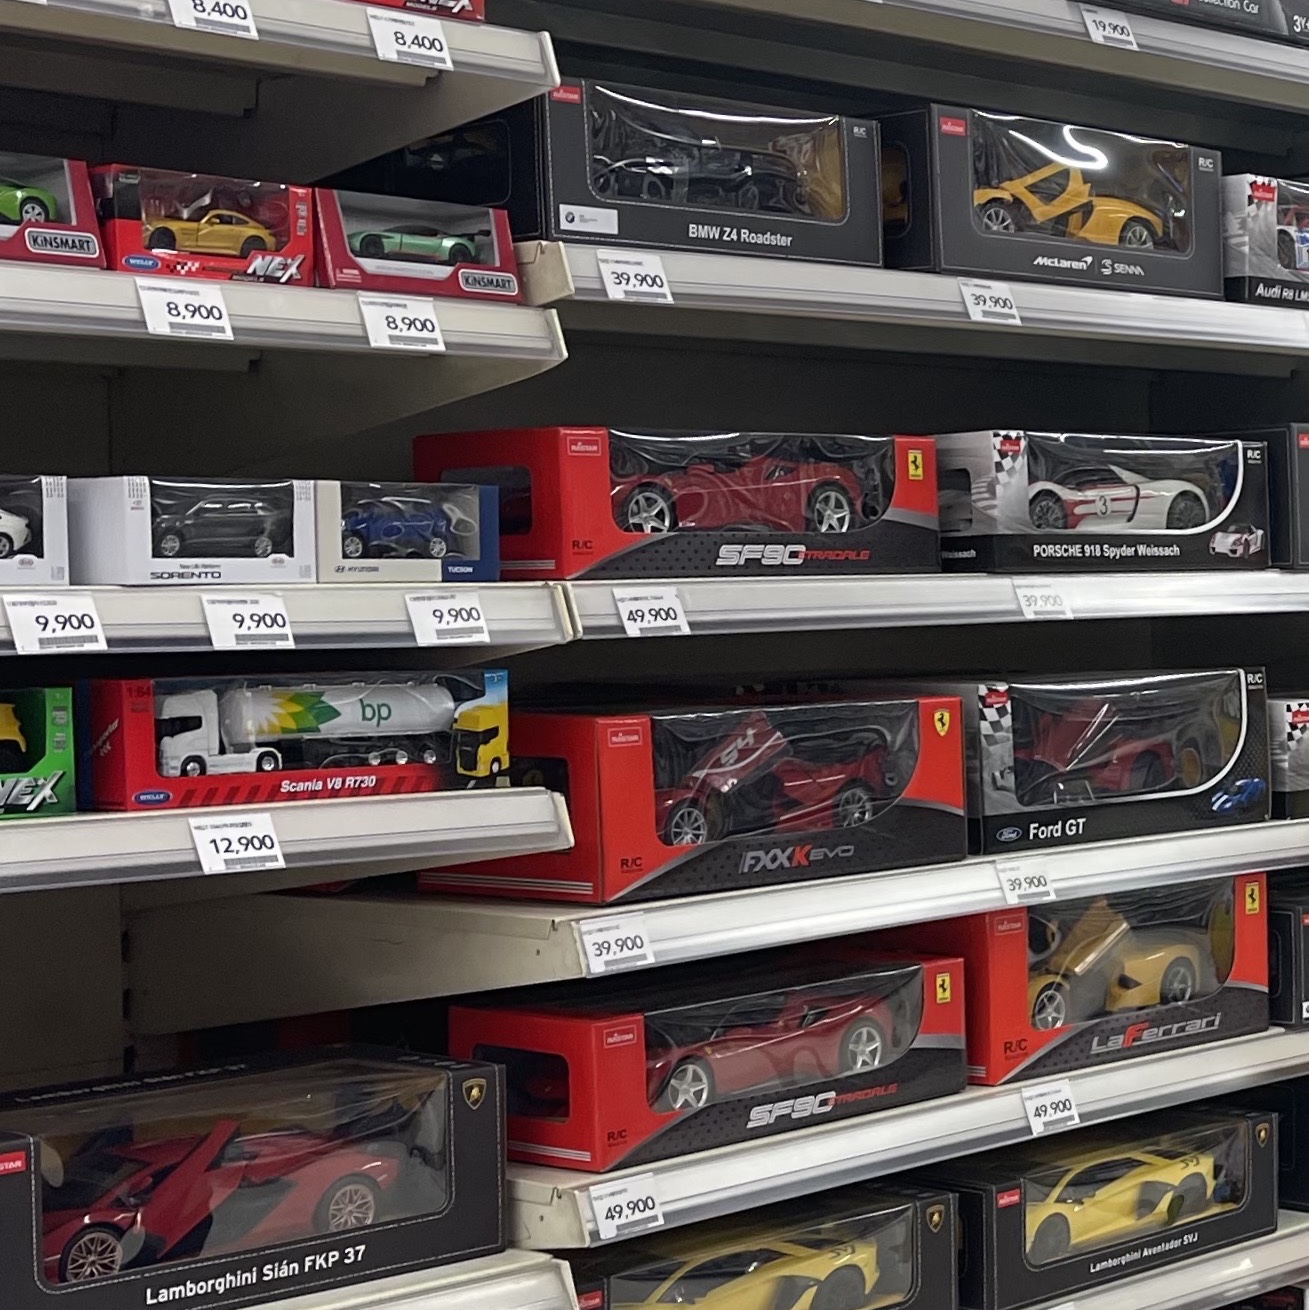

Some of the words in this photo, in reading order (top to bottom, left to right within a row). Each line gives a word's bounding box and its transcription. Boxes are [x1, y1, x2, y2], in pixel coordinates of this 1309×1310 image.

[193, 0, 247, 21] 8,400
[1092, 17, 1130, 38] 19,900
[395, 30, 443, 53] 8,400
[688, 224, 722, 242] BMW
[723, 226, 739, 243] Z4
[740, 227, 793, 248] Roadster
[246, 255, 305, 283] NEX
[1033, 256, 1090, 271] McLaren
[610, 270, 665, 290] 39,900
[1255, 282, 1282, 298] Audi
[1282, 287, 1294, 300] R8
[167, 300, 223, 322] 8,900
[971, 292, 1014, 311] 39,900
[386, 314, 435, 334] 8,900
[572, 539, 593, 550] R/C
[1033, 544, 1083, 559] PORSCHE
[1084, 544, 1101, 558] 918
[1102, 544, 1136, 560] Spyder
[1137, 543, 1180, 558] Weissach
[716, 544, 806, 567] SF90
[150, 571, 221, 580] SORENTO
[35, 613, 95, 634] 9,900
[233, 612, 286, 630] 9,900
[432, 606, 481, 623] 9,900
[626, 607, 678, 623] 49,900
[1247, 673, 1263, 684] R/C
[360, 698, 392, 726] bp
[281, 777, 324, 794] Scania
[326, 776, 342, 791] V8
[345, 775, 377, 789] R730
[1029, 820, 1063, 841] Ford
[1065, 818, 1087, 836] GT
[209, 834, 275, 854] 12,900
[620, 856, 643, 870] R/C
[1007, 874, 1049, 893] 39,900
[592, 935, 645, 958] 39,900
[1090, 1012, 1222, 1054] LaFerrari
[1003, 1036, 1029, 1056] R/C
[746, 1090, 836, 1129] SF90
[1034, 1098, 1073, 1120] 49,900
[607, 1128, 628, 1143] R/C
[0, 1159, 22, 1171] STAR
[604, 1196, 656, 1221] 49,900
[1089, 1250, 1142, 1274] Lamborghini
[1142, 1239, 1183, 1261] Aventador
[1183, 1231, 1199, 1247] SVJ
[146, 1267, 258, 1305] Lamborghini
[262, 1258, 300, 1283] Sián
[304, 1250, 341, 1274] FKP
[344, 1245, 367, 1266] 37
